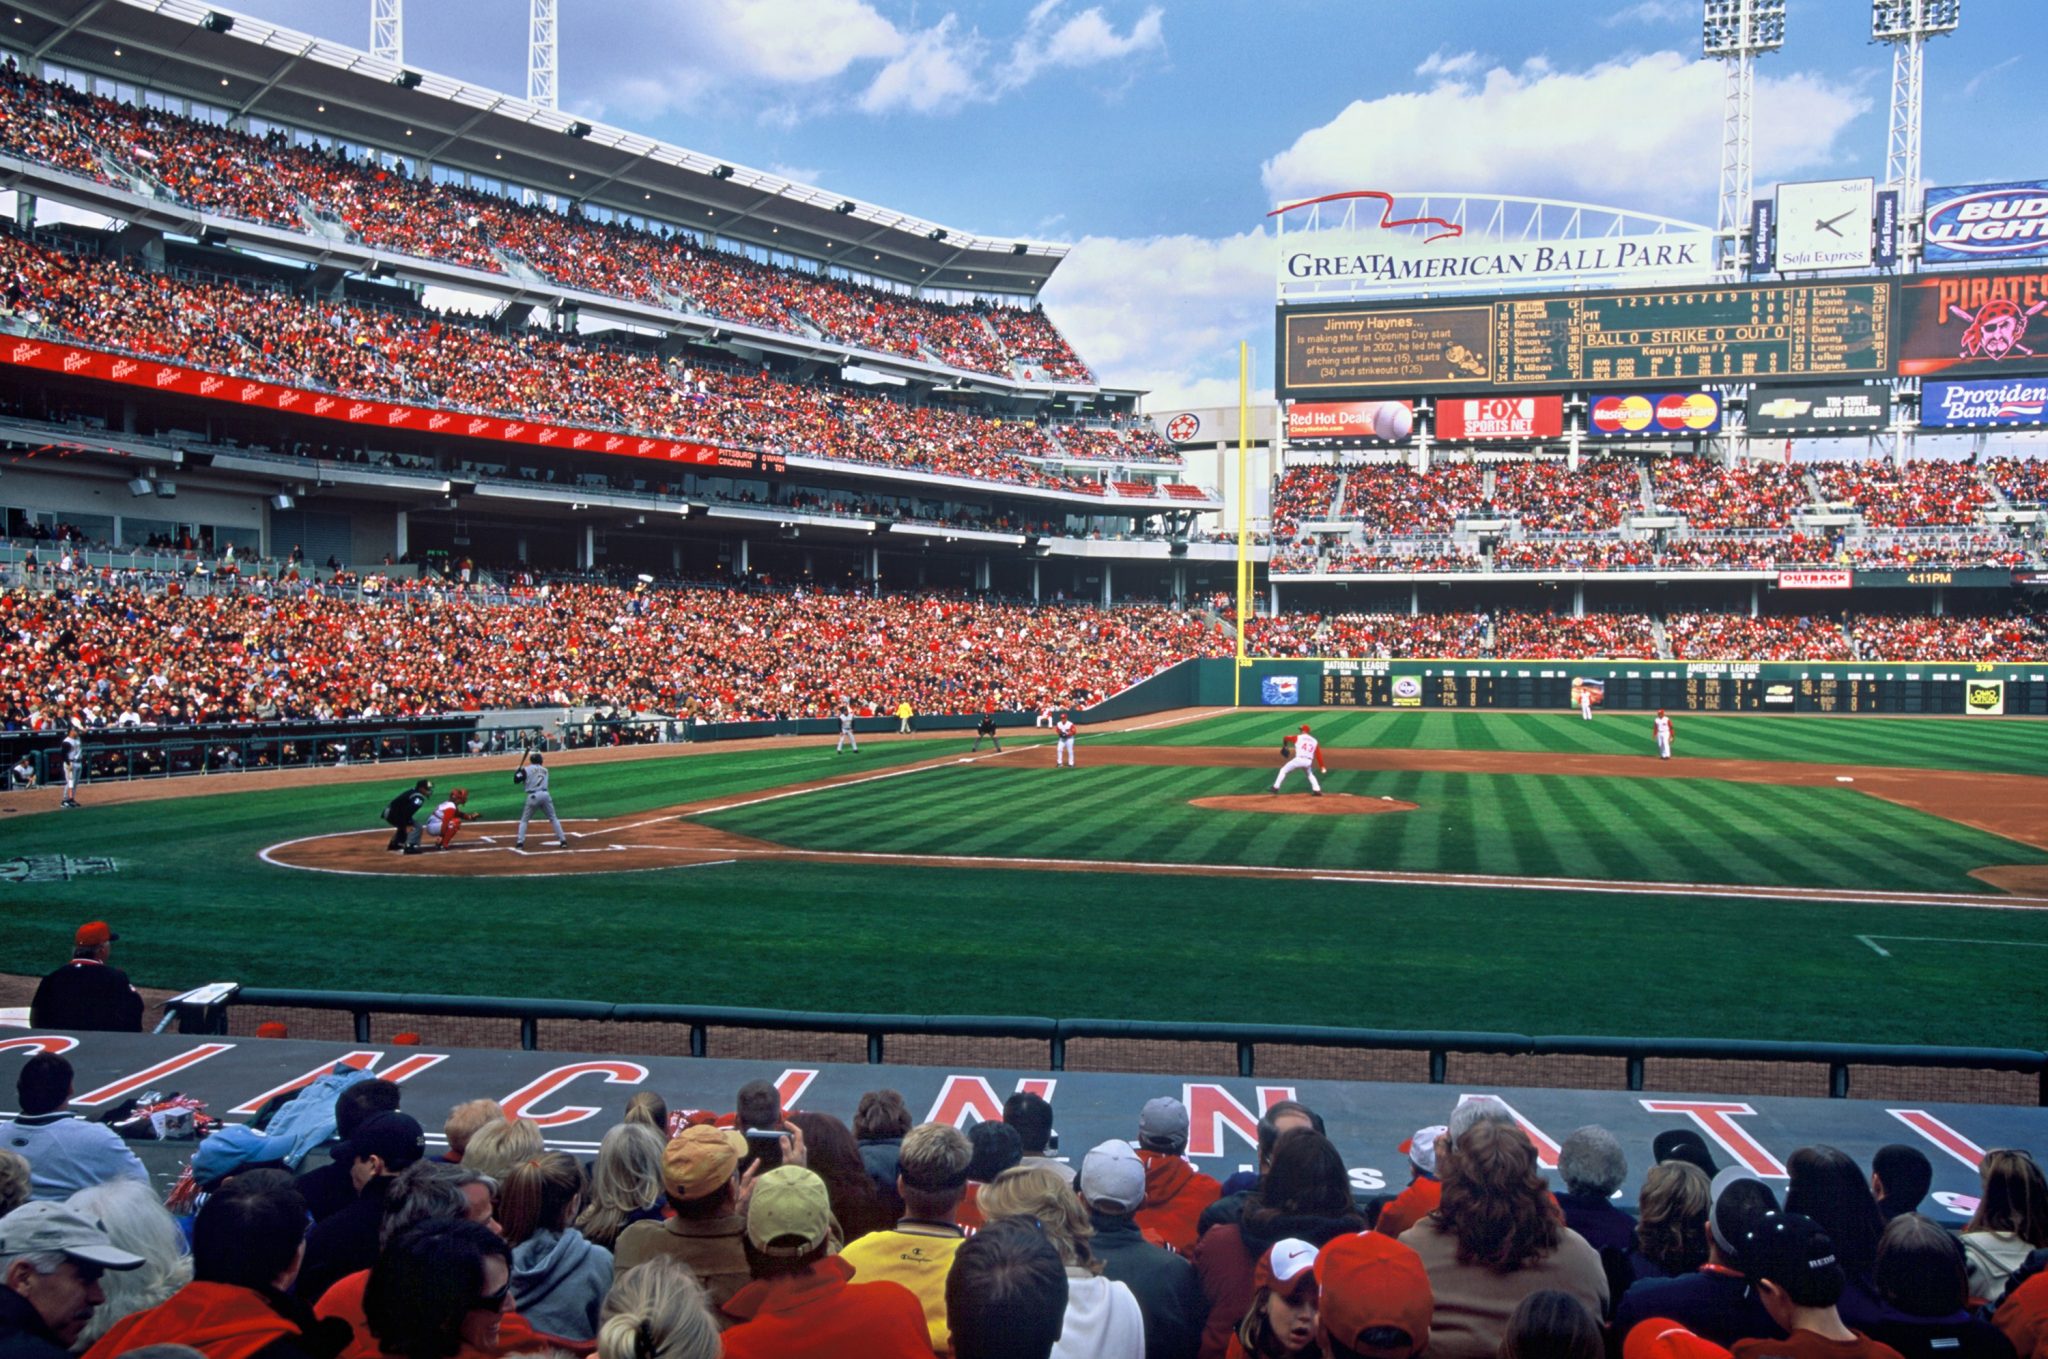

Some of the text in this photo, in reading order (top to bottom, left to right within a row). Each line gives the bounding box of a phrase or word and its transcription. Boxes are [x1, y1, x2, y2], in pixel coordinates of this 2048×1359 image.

[1841, 182, 1867, 193] Sofa!
[1957, 198, 2048, 221] BUD
[1881, 200, 1894, 258] Sofa Express
[1935, 218, 2048, 241] LIGHT
[1756, 208, 1768, 264] Sofa Express
[1288, 242, 1698, 281] GREAT AMERICAN BALL PARK
[1782, 250, 1864, 265] Sofa Express
[1617, 290, 1790, 307] 1 2 3 4 5 6 7 8 9 R H E
[1813, 288, 1846, 297] Larkin
[1813, 298, 1843, 306] Boone
[1938, 274, 2048, 325] PIRATES
[1584, 302, 1790, 320] PIT 0 0 0
[1812, 306, 1848, 316] Griffey
[1324, 317, 1424, 332] Jimmy Haynes...
[1584, 314, 1790, 332] CIN 0 0 0
[1812, 316, 1848, 324] Kearns
[1587, 326, 1784, 346] BALL 0 STRIKE 0 OUT 0
[1812, 325, 1836, 334] Dunn
[1308, 334, 1338, 344] making
[1340, 333, 1354, 342] the
[1356, 332, 1372, 341] first
[1374, 331, 1410, 342] Opening
[1412, 330, 1428, 340] Day
[1432, 330, 1451, 338] start
[1812, 334, 1842, 344] Casey
[20, 343, 31, 352] Dr
[1306, 346, 1314, 354] of
[1316, 346, 1328, 354] his
[1363, 344, 1371, 352] In
[1399, 342, 1410, 350] he
[1412, 342, 1425, 350] led
[1427, 341, 1442, 350] the
[1642, 346, 1674, 358] Kenny
[1676, 344, 1709, 354] Lofton
[1720, 344, 1728, 352] 7
[1812, 344, 1848, 352] Larson
[13, 348, 42, 362] Pepper
[70, 352, 81, 360] Dr
[1306, 357, 1340, 368] pitching
[1342, 355, 1361, 364] staff
[1416, 353, 1440, 362] starts
[1811, 352, 1842, 361] LaRue
[64, 356, 91, 372] Pepper
[118, 360, 128, 368] Dr
[1811, 362, 1847, 372] Haynes
[112, 364, 138, 378] Pepper
[163, 368, 172, 376] Dr
[1320, 368, 1336, 378] (34)
[1339, 368, 1355, 376] and
[1358, 366, 1398, 376] strikeouts
[157, 372, 182, 386] Pepper
[206, 376, 216, 384] Dr
[200, 380, 224, 394] Pepper
[1826, 396, 1868, 407] TRI-STATE
[1941, 384, 2048, 408] Providen
[1478, 399, 1523, 420] FOX
[1594, 409, 1652, 420] MasterCard
[1656, 407, 1716, 418] MasterCard
[1813, 405, 1881, 418] CHEVY DEALERS
[1946, 402, 2000, 420] Bank
[1290, 411, 1372, 426] Red Hot Deals
[1465, 418, 1533, 432] SPORTS NET
[718, 448, 757, 461] PITTSBURGH
[718, 458, 752, 468] CINCINNATI
[1783, 574, 1846, 582] OUTBACK
[1907, 573, 1951, 584] 4:11PM
[1324, 661, 1390, 670] NATIONAL LEAGUE
[1687, 663, 1760, 674] AMERICAN LEAGUE
